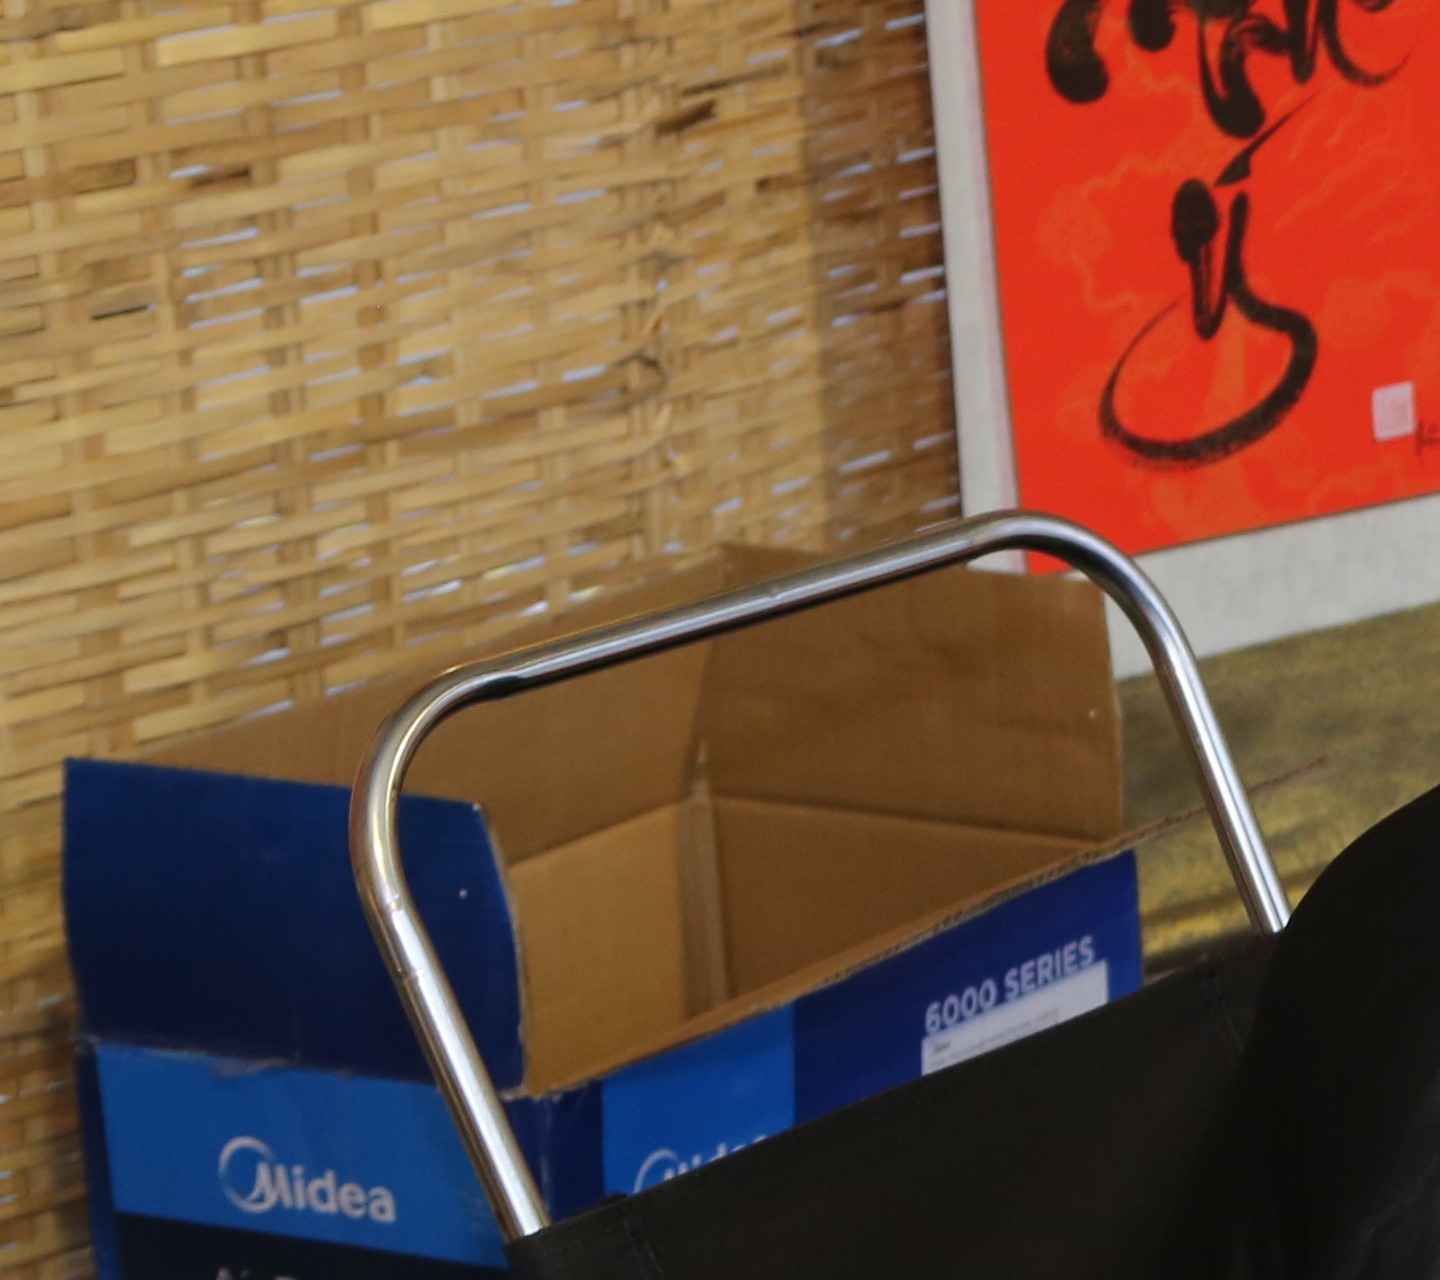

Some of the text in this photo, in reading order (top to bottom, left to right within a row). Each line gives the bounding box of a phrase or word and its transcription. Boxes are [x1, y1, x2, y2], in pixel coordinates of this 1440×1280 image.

[925, 934, 1096, 1035] 6000 SERIES
[219, 1135, 397, 1223] Midea
